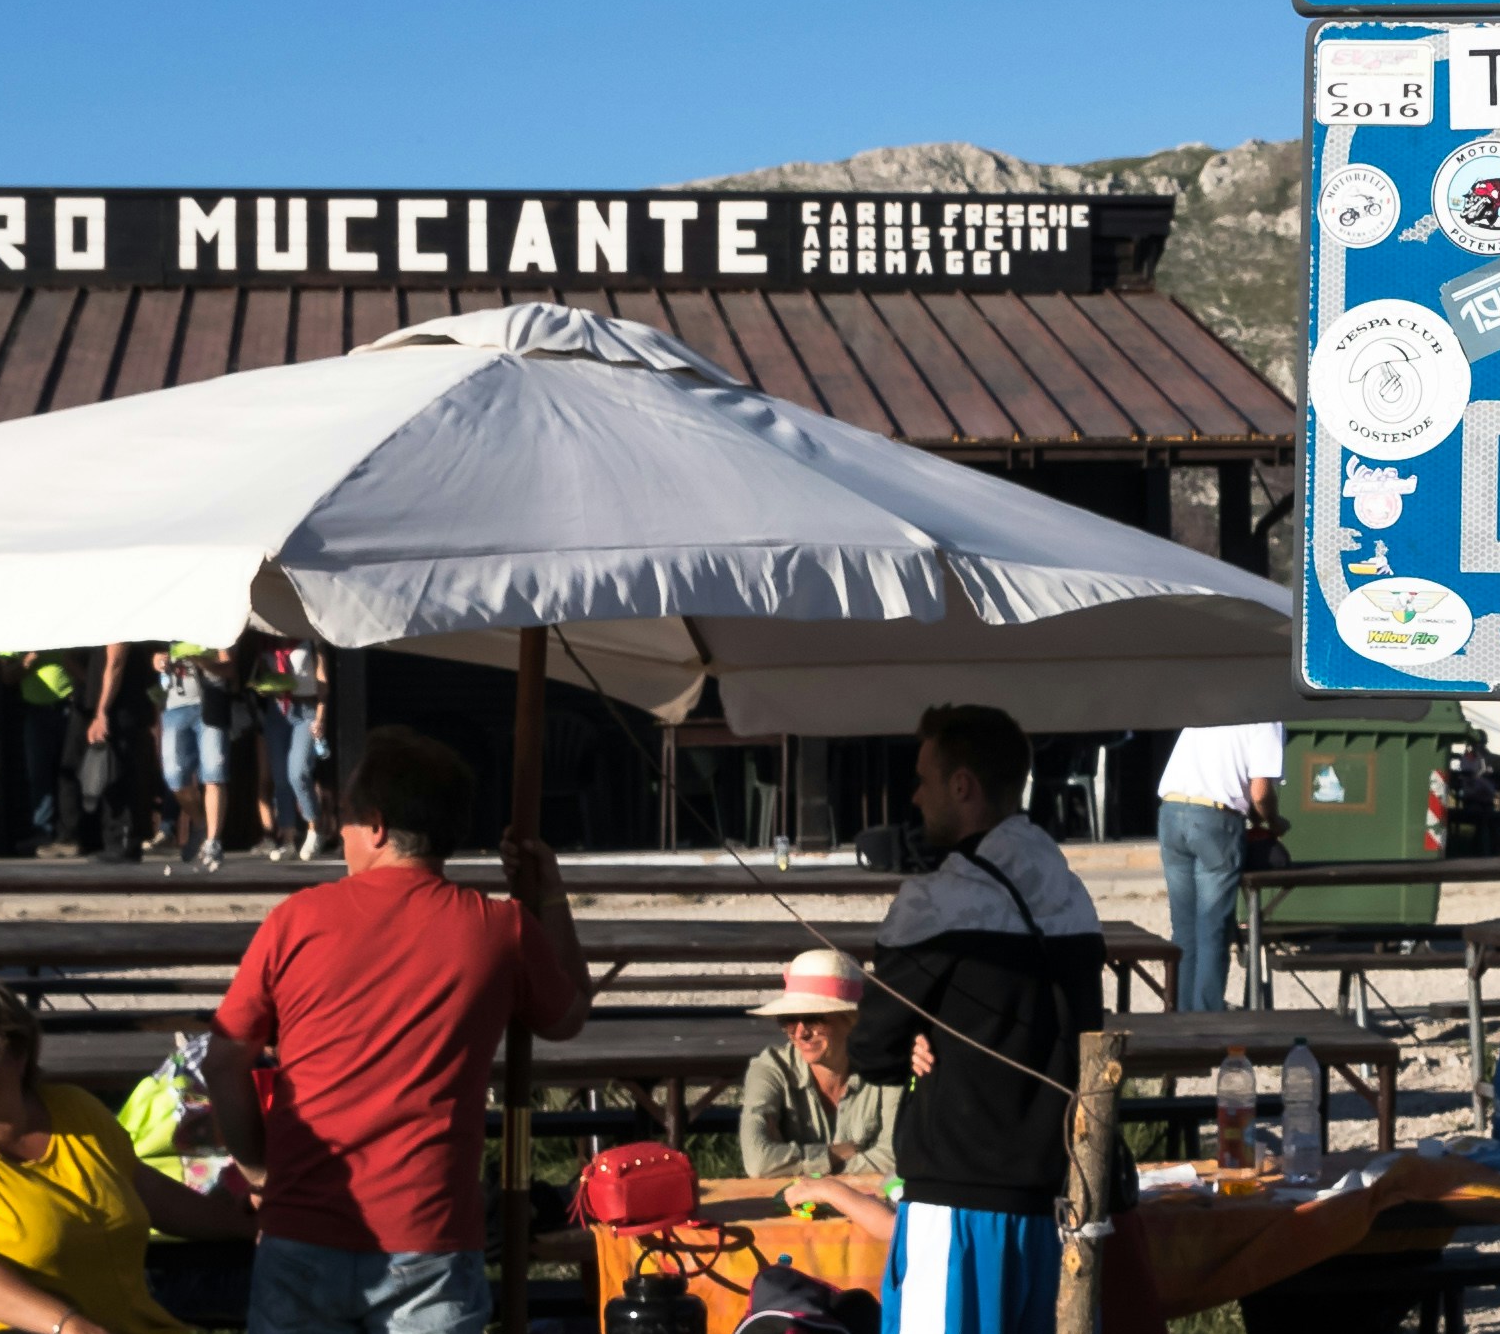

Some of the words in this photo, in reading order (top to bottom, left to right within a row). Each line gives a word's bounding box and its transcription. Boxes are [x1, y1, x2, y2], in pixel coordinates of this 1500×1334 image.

[1327, 83, 1348, 98] C
[1403, 83, 1423, 98] R
[1330, 103, 1419, 117] 2016
[1327, 172, 1387, 199] MOTORELLI
[802, 202, 921, 225] CARNI
[944, 204, 1089, 228] FRESCHE
[178, 195, 771, 274] MUCCIANTE
[804, 226, 1067, 251] ARROSTICINI
[802, 250, 1010, 275] FORMAGGI
[1335, 318, 1392, 354] VESPA
[1397, 318, 1443, 355] CLUB
[1347, 415, 1435, 443] OOSTENDE
[1366, 630, 1411, 645] Yellow
[1411, 632, 1439, 646] Fire
